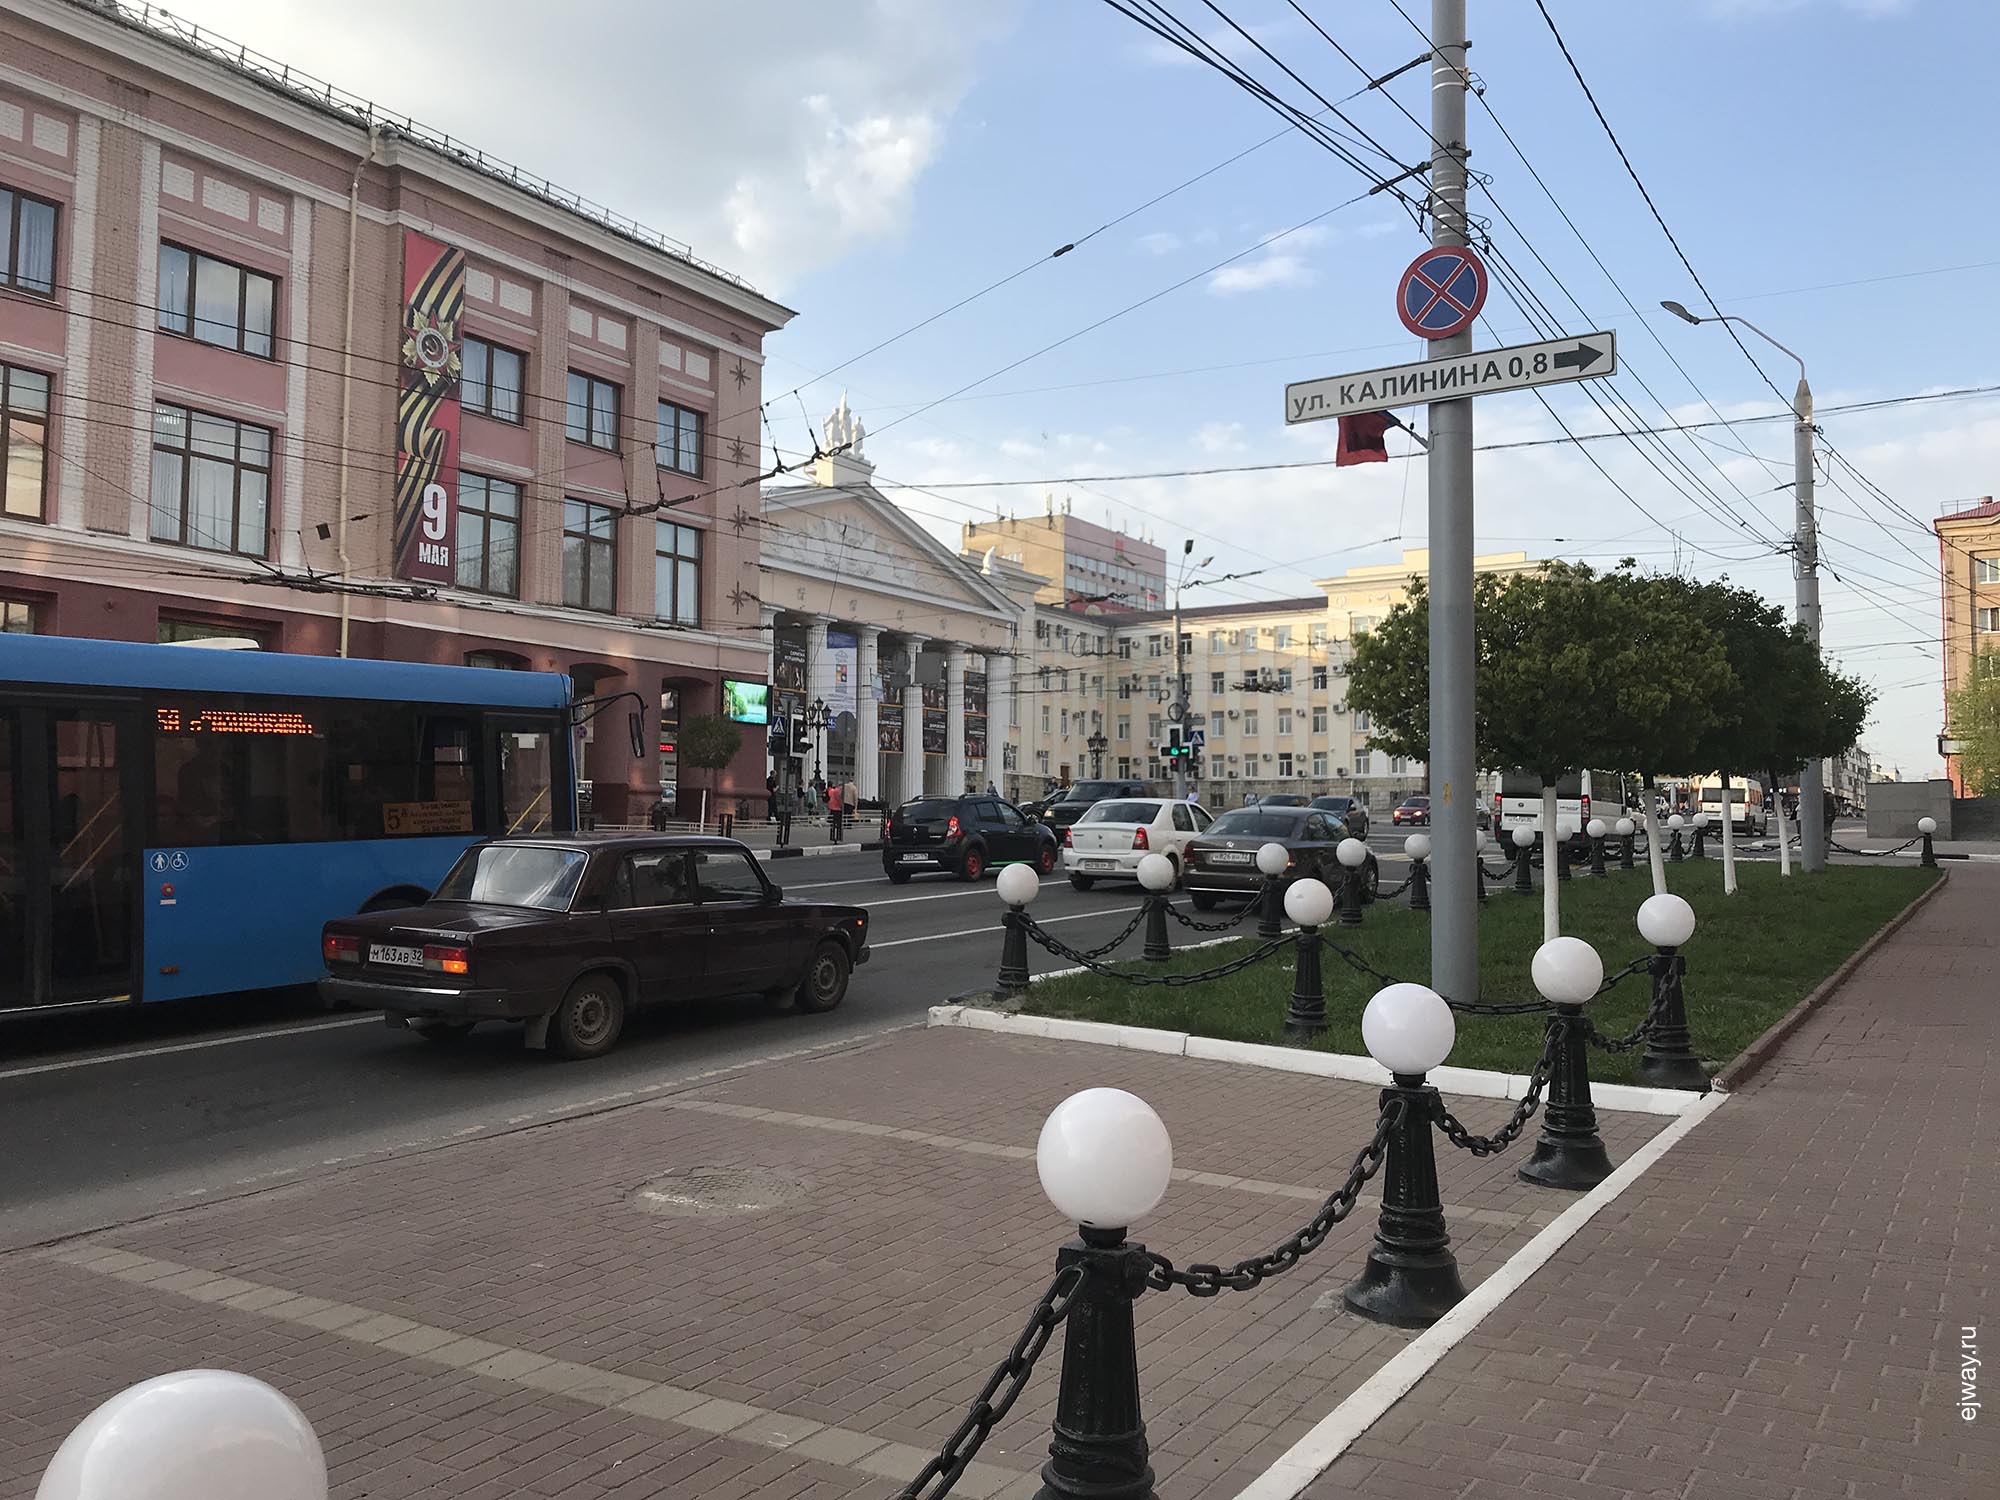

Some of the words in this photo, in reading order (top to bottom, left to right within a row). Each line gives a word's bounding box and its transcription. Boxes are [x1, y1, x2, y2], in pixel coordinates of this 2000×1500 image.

[1293, 392, 1331, 418] ул.
[1340, 360, 1502, 407] КАЛИНИНА
[1508, 353, 1548, 383] 0,8
[423, 483, 447, 540] 9
[419, 542, 448, 567] МАЯ
